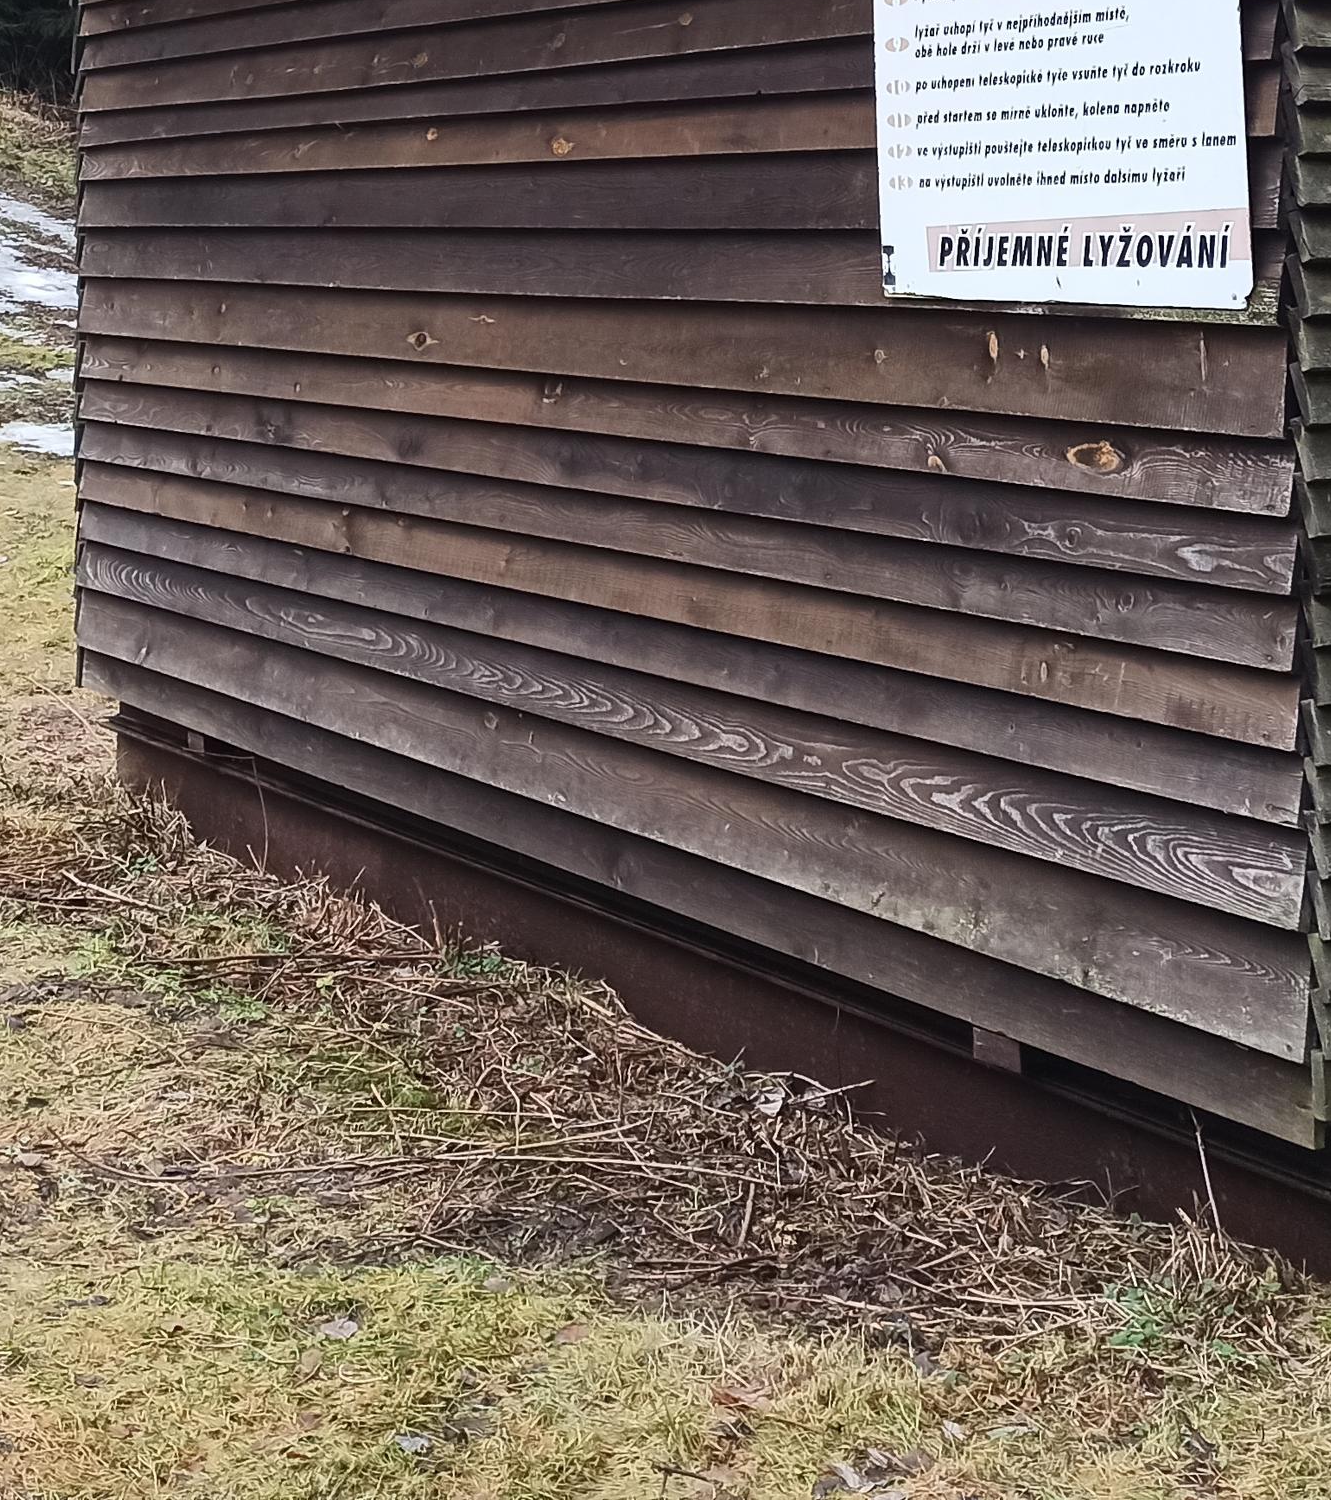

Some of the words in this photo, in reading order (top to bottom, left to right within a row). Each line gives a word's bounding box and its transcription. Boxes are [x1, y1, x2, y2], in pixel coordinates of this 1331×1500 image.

[914, 23, 940, 42] lyžař
[979, 18, 994, 36] tyč
[996, 21, 1003, 31] v
[936, 41, 958, 57] hole
[984, 42, 991, 53] v
[1018, 34, 1044, 51] nebo
[1081, 33, 1105, 45] ruce
[915, 80, 928, 95] po
[978, 68, 1043, 89] teleskopické
[1046, 67, 1068, 87] tyče
[1112, 63, 1129, 82] tyč
[1131, 60, 1146, 77] do
[1149, 56, 1201, 76] rozkroku
[915, 109, 940, 130] před
[943, 109, 983, 124] startem
[986, 110, 997, 122] se
[1082, 100, 1120, 117] kolena
[917, 146, 929, 157] ve
[1037, 135, 1112, 156] teleskopickou
[1115, 135, 1132, 155] tyč
[1135, 138, 1149, 149] ve
[1152, 133, 1188, 149] směru
[1191, 136, 1198, 148] s
[1201, 131, 1237, 147] lanem
[918, 178, 932, 189] na
[1036, 170, 1067, 186] ihned
[1069, 170, 1100, 185] místo
[938, 225, 1069, 268] PŘÍJEMNÉ
[1082, 224, 1230, 269] LYŽOVÁNÍ
